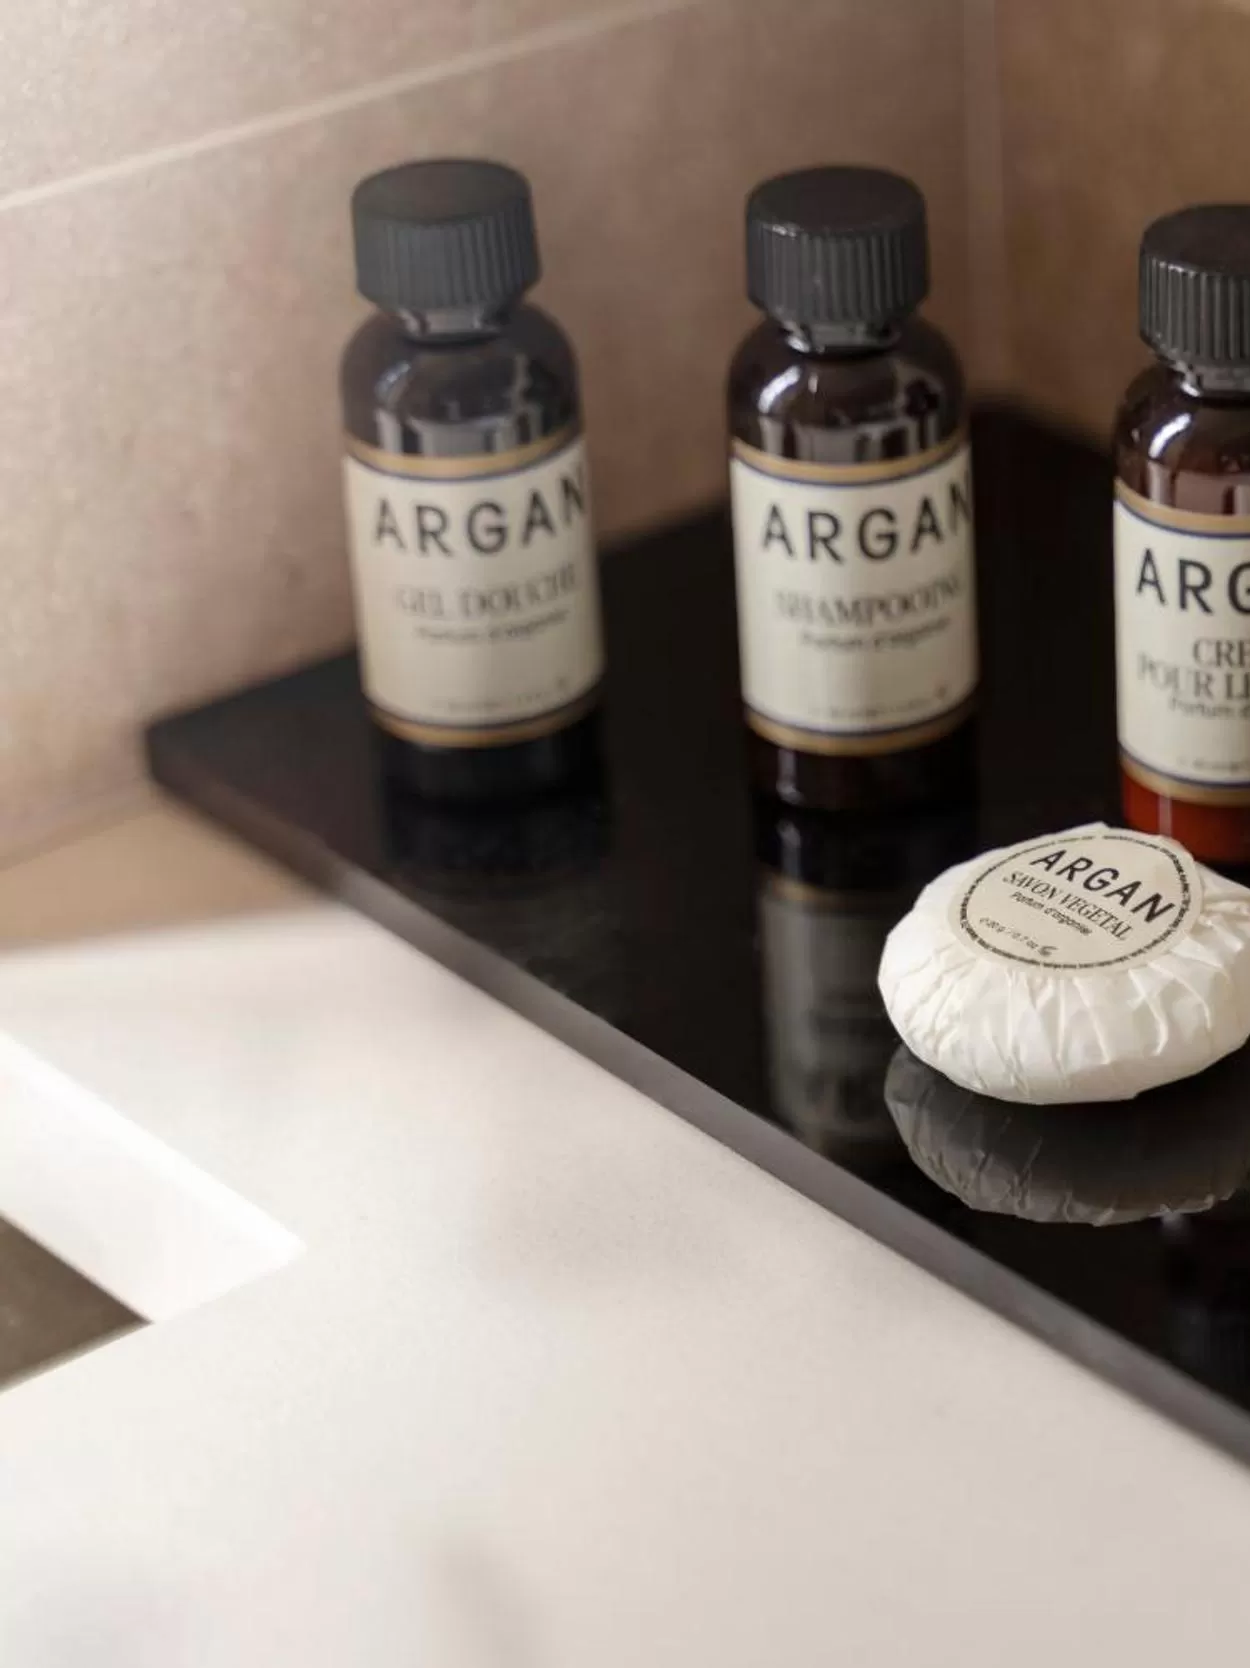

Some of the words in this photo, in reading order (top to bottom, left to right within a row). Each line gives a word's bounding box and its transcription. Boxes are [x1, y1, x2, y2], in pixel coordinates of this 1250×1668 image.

[374, 464, 586, 557] ARGAN
[763, 471, 972, 565] ARGAN
[1137, 652, 1214, 698] POUR
[1003, 871, 1062, 900] SAVON
[1059, 893, 1133, 941] VEGETAL
[1029, 849, 1176, 923] ARGAN
